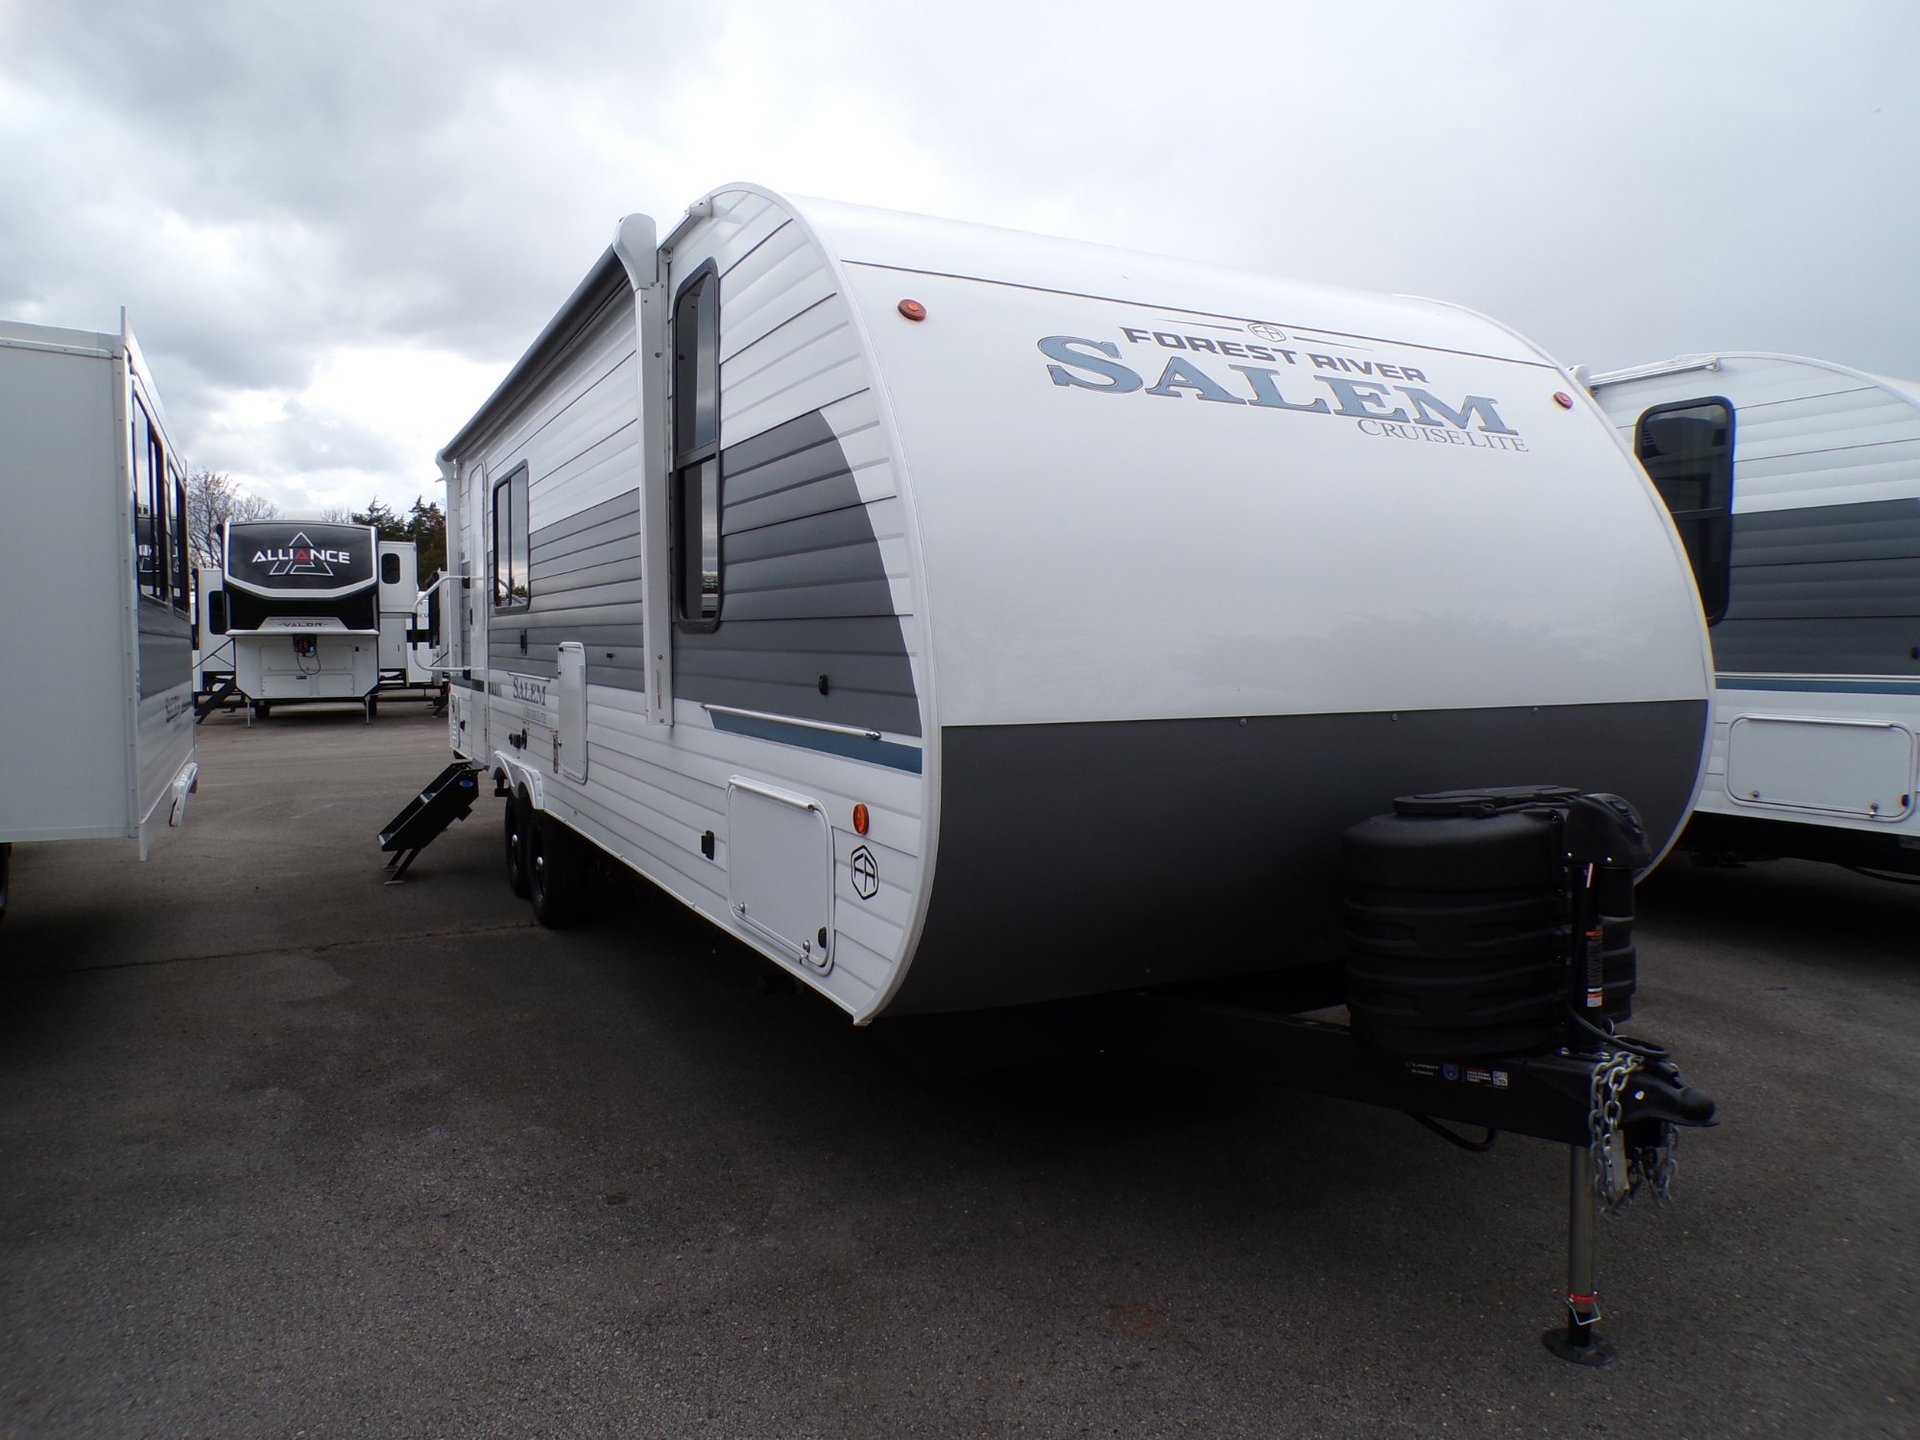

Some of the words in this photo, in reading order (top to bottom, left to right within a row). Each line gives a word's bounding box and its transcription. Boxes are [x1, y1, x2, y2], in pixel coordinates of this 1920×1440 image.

[1118, 326, 1297, 364] FOREST
[1305, 351, 1431, 383] RIVER
[1037, 335, 1520, 436] SALEM
[251, 548, 351, 564] ALLIANCE
[513, 676, 546, 706] SALEM
